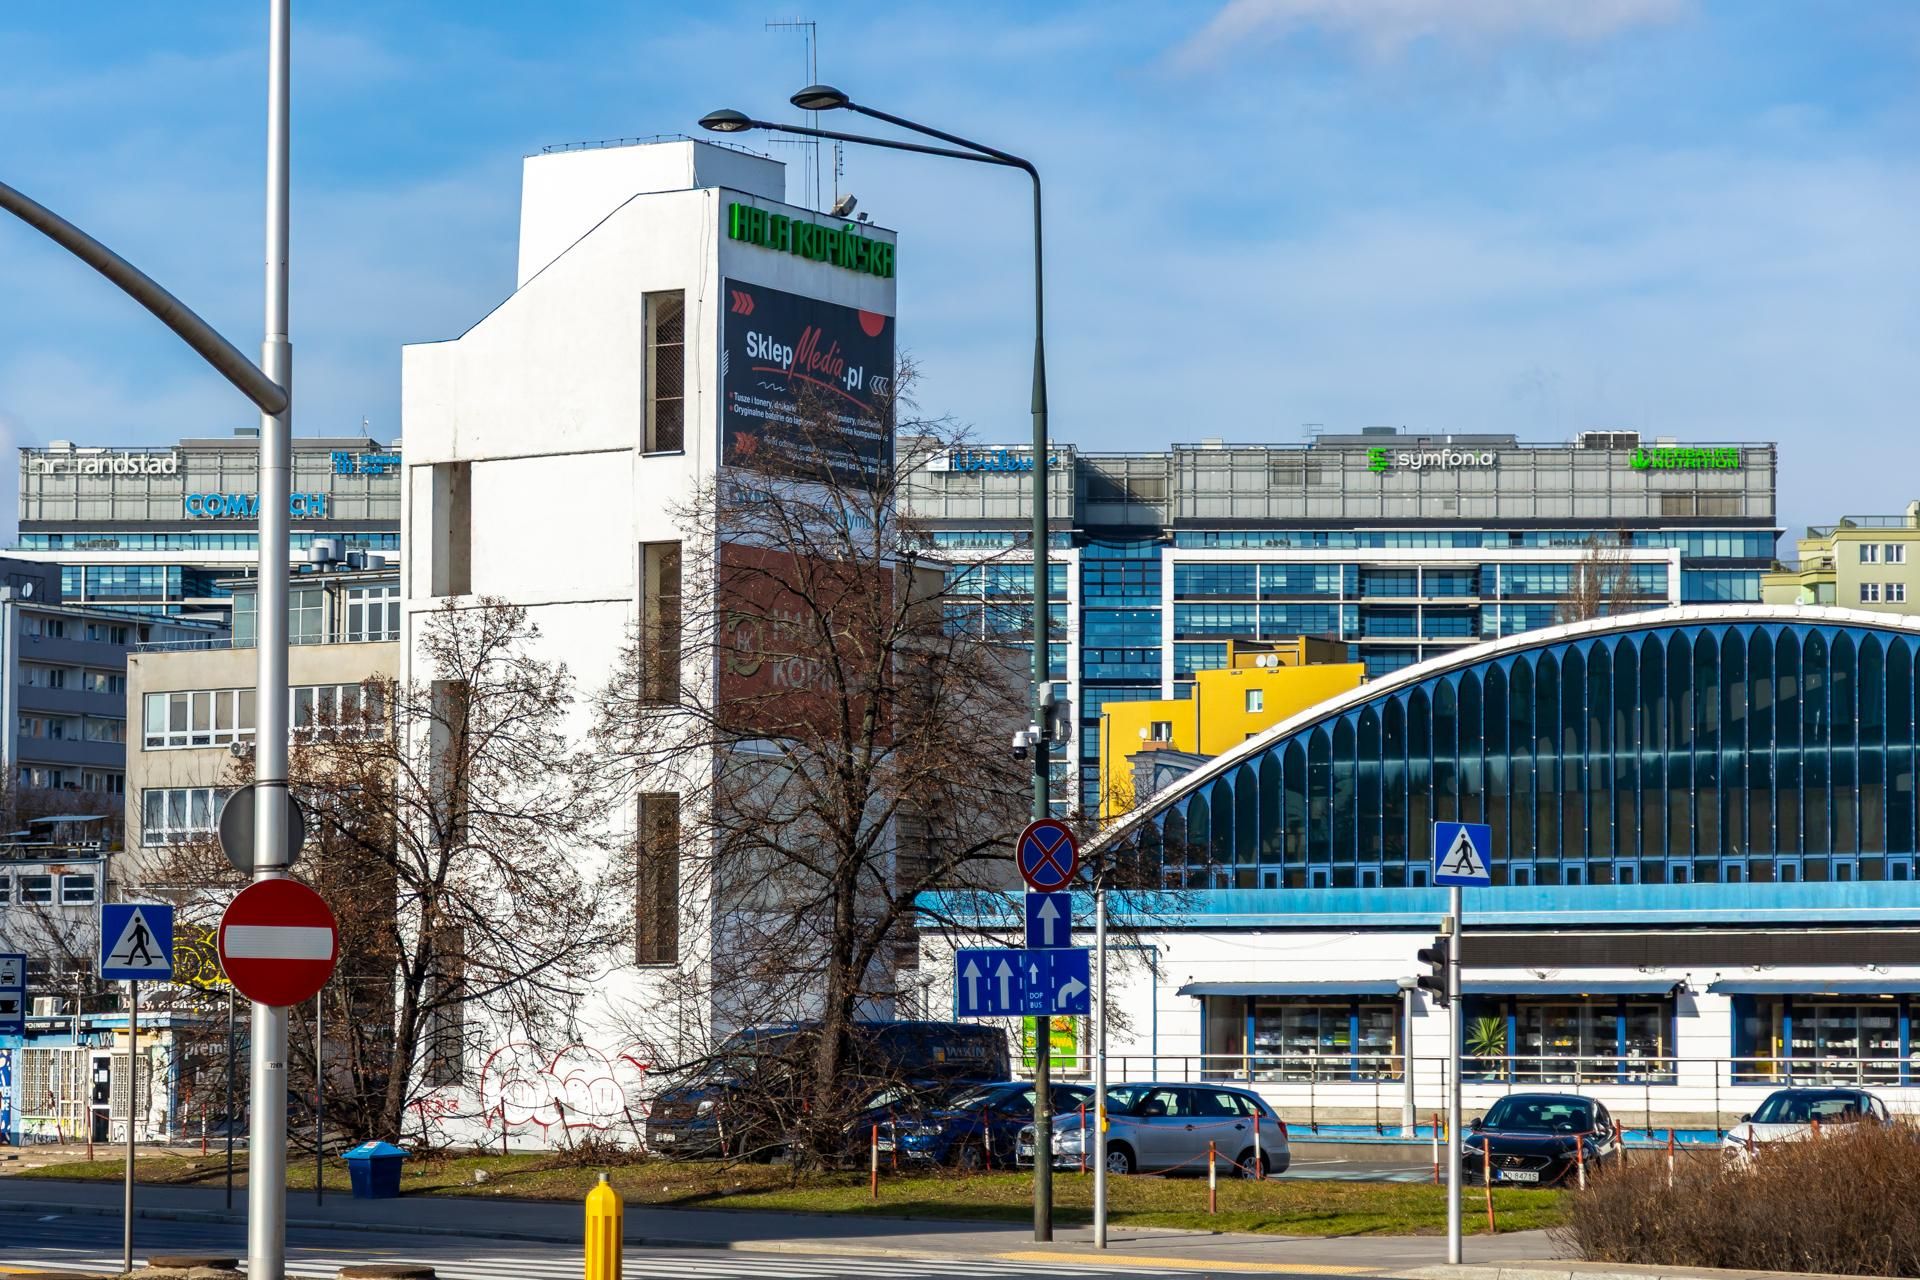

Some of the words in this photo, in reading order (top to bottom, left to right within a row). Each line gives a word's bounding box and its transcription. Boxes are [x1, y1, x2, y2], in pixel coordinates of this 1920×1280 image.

[729, 202, 790, 251] HALA
[792, 220, 895, 278] KOPIŃSKA
[77, 451, 177, 474] randstad
[1399, 448, 1493, 469] symfonia
[1653, 447, 1738, 458] HERBALIFE
[1653, 458, 1739, 469] NUTRITION
[185, 492, 325, 516] COMCH
